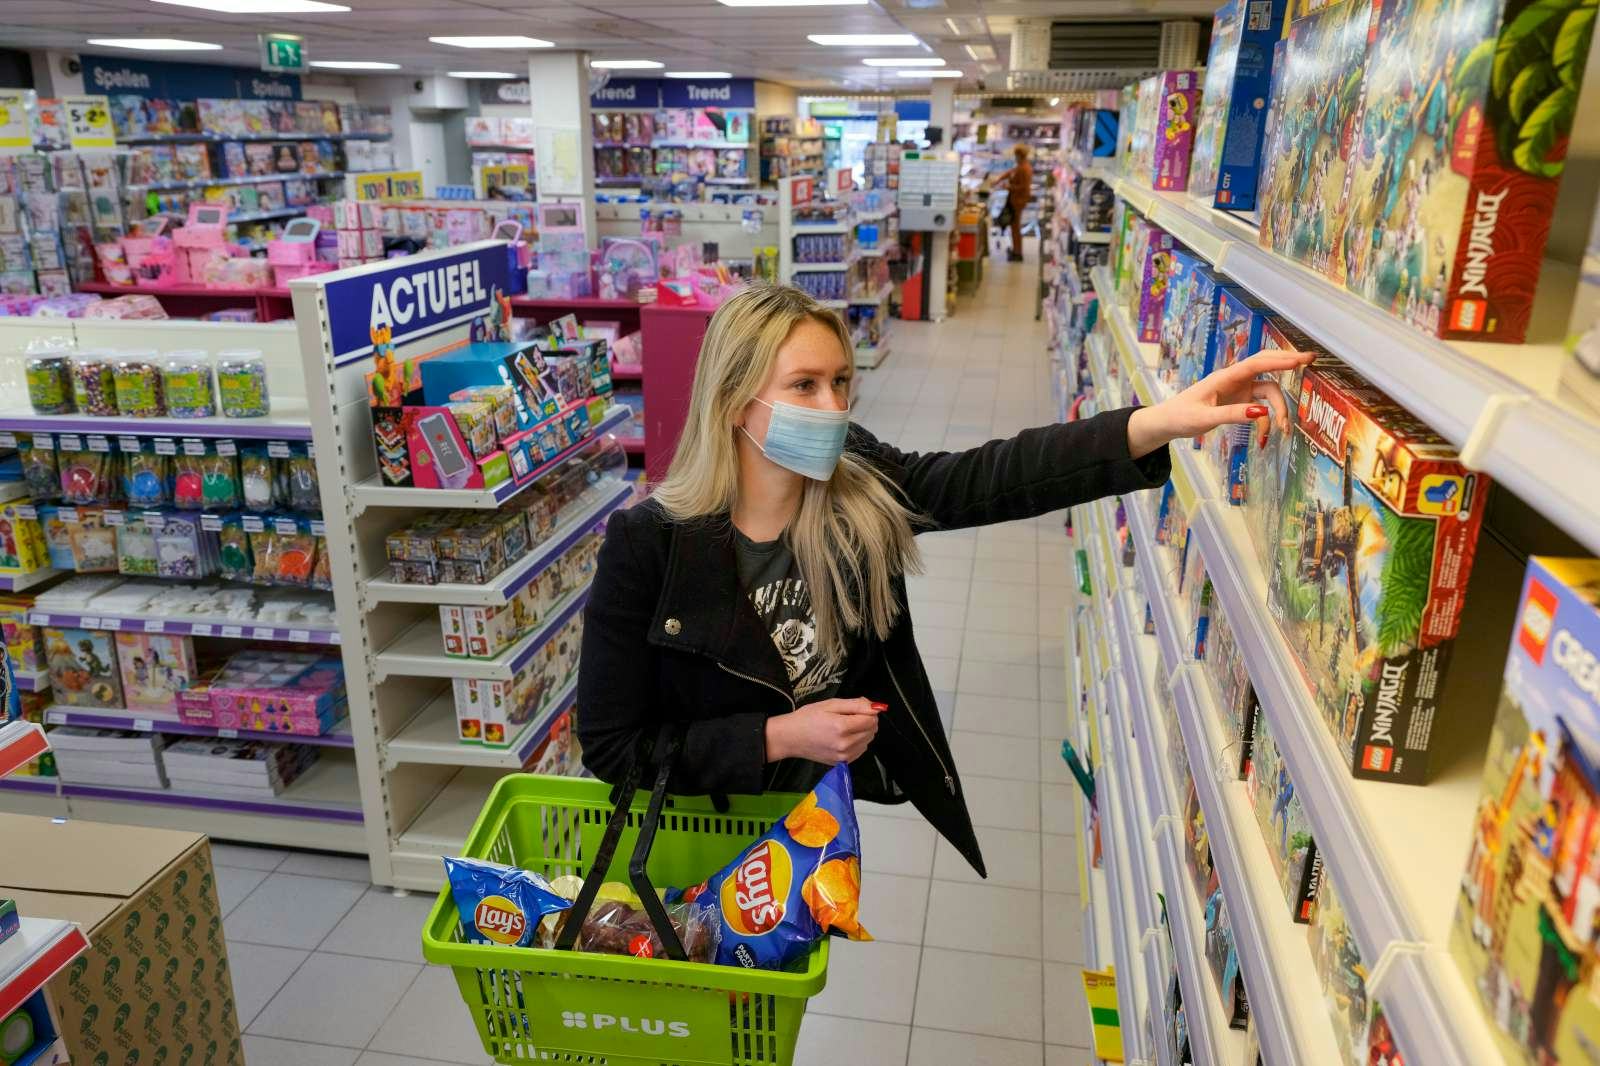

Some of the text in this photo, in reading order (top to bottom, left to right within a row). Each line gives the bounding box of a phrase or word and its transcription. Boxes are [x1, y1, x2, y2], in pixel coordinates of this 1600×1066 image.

[94, 66, 150, 90] Spellen
[687, 84, 731, 100] Trend
[363, 182, 385, 199] TOP
[395, 179, 420, 196] TOYS
[1459, 187, 1509, 299] NINJAGO
[370, 259, 487, 331] ACTUEEL
[1306, 390, 1347, 457] NINJAGO
[1369, 660, 1410, 747] NINJAGO
[735, 846, 777, 926] Lay's
[477, 904, 523, 934] Lay's
[737, 943, 756, 968] PARTY
[592, 1012, 691, 1038] PLUS
